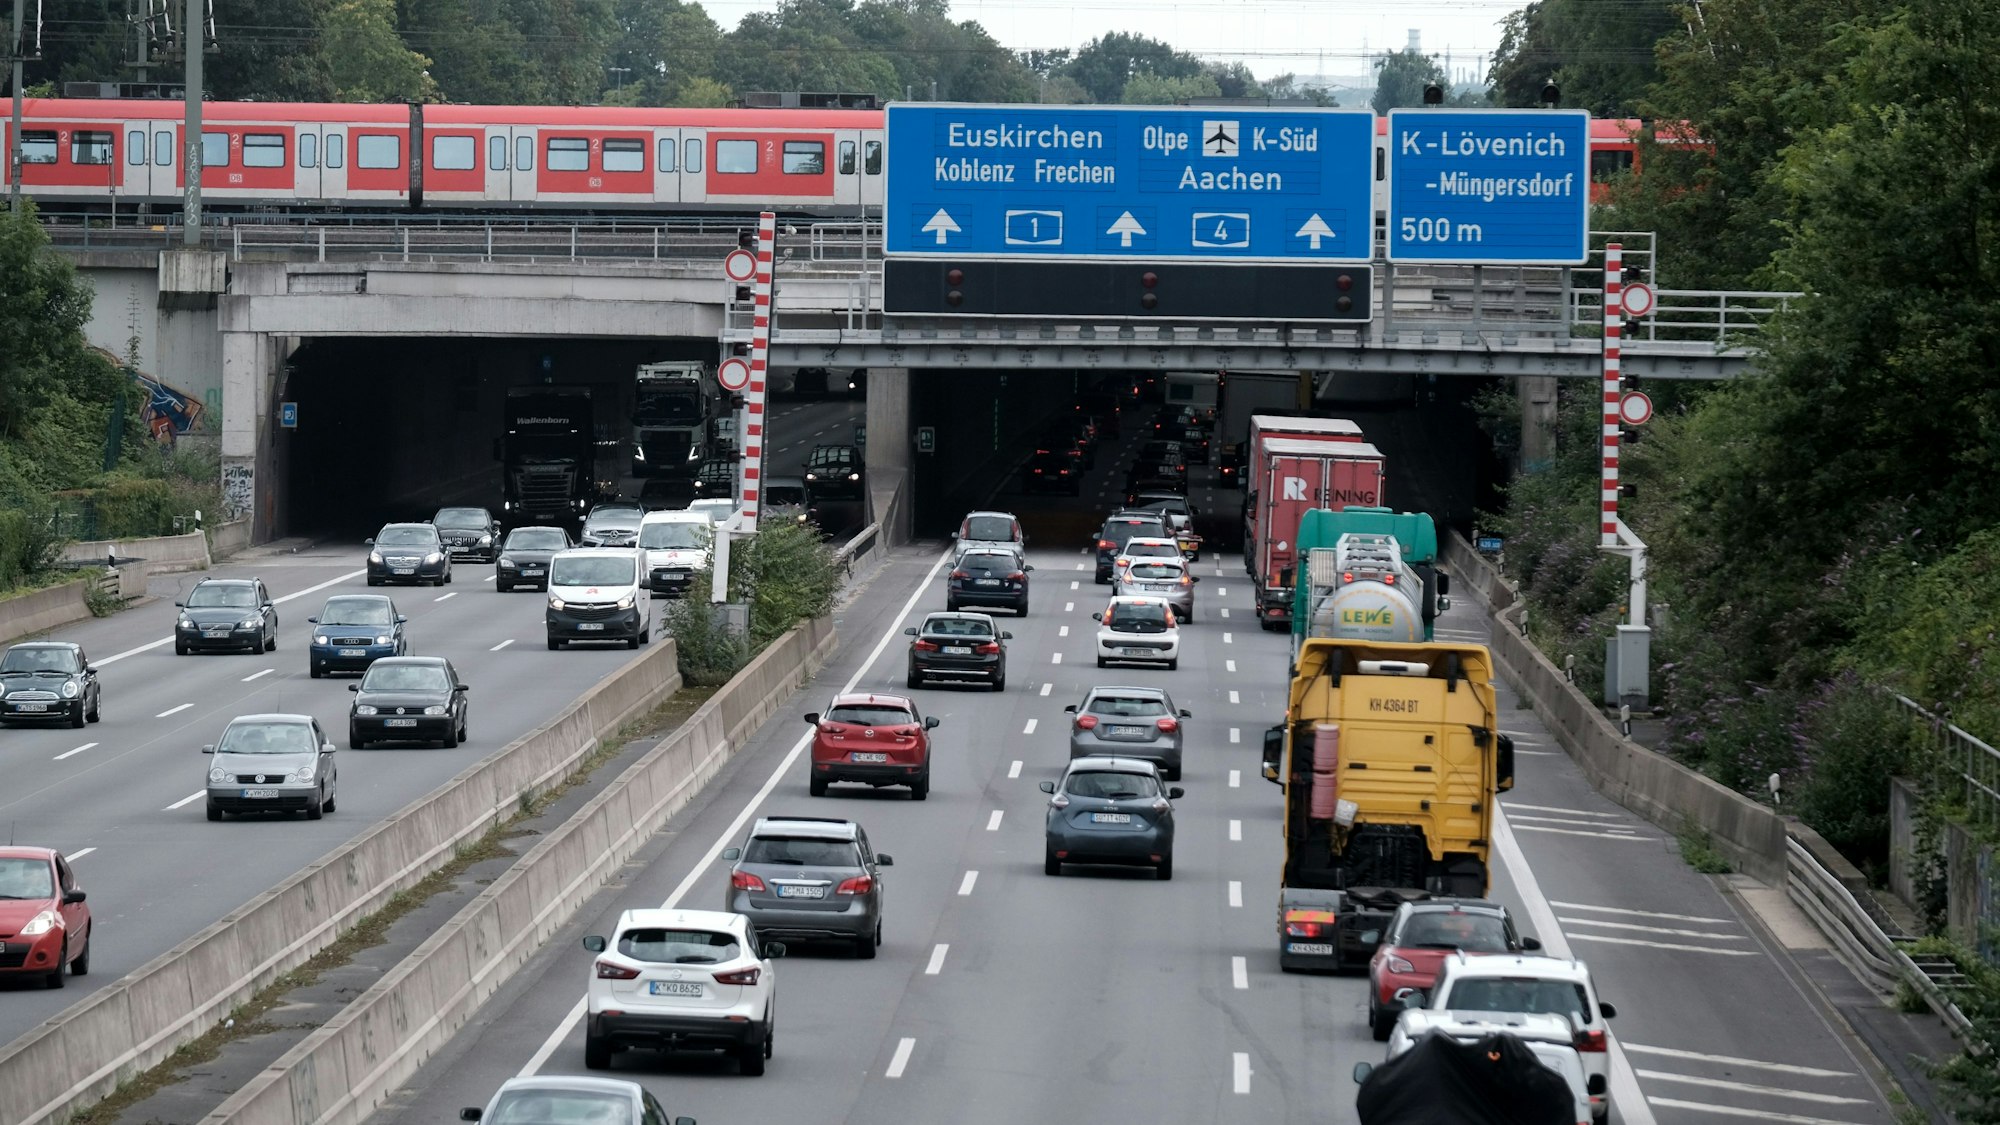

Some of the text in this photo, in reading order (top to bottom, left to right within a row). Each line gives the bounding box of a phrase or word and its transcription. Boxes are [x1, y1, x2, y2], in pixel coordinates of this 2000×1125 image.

[60, 131, 68, 142] 2
[232, 133, 240, 145] 2
[949, 122, 1103, 149] Euskirchen
[1143, 125, 1318, 156] Olpe K-Süd
[592, 138, 599, 149] 2
[766, 141, 774, 152] 2
[229, 173, 242, 183] DB
[935, 157, 1115, 184] Koblenz Frechen
[1178, 165, 1282, 191] Aachen
[1030, 217, 1038, 238] 1
[1213, 219, 1228, 241] 4
[1402, 217, 1482, 242] 500 m
[516, 416, 570, 425] Wallenborn
[1343, 606, 1391, 625] LEWE
[1369, 698, 1419, 713] KH 4364 BT
[783, 887, 792, 895] AC
[655, 983, 661, 991] K
[679, 984, 701, 993] 8625
